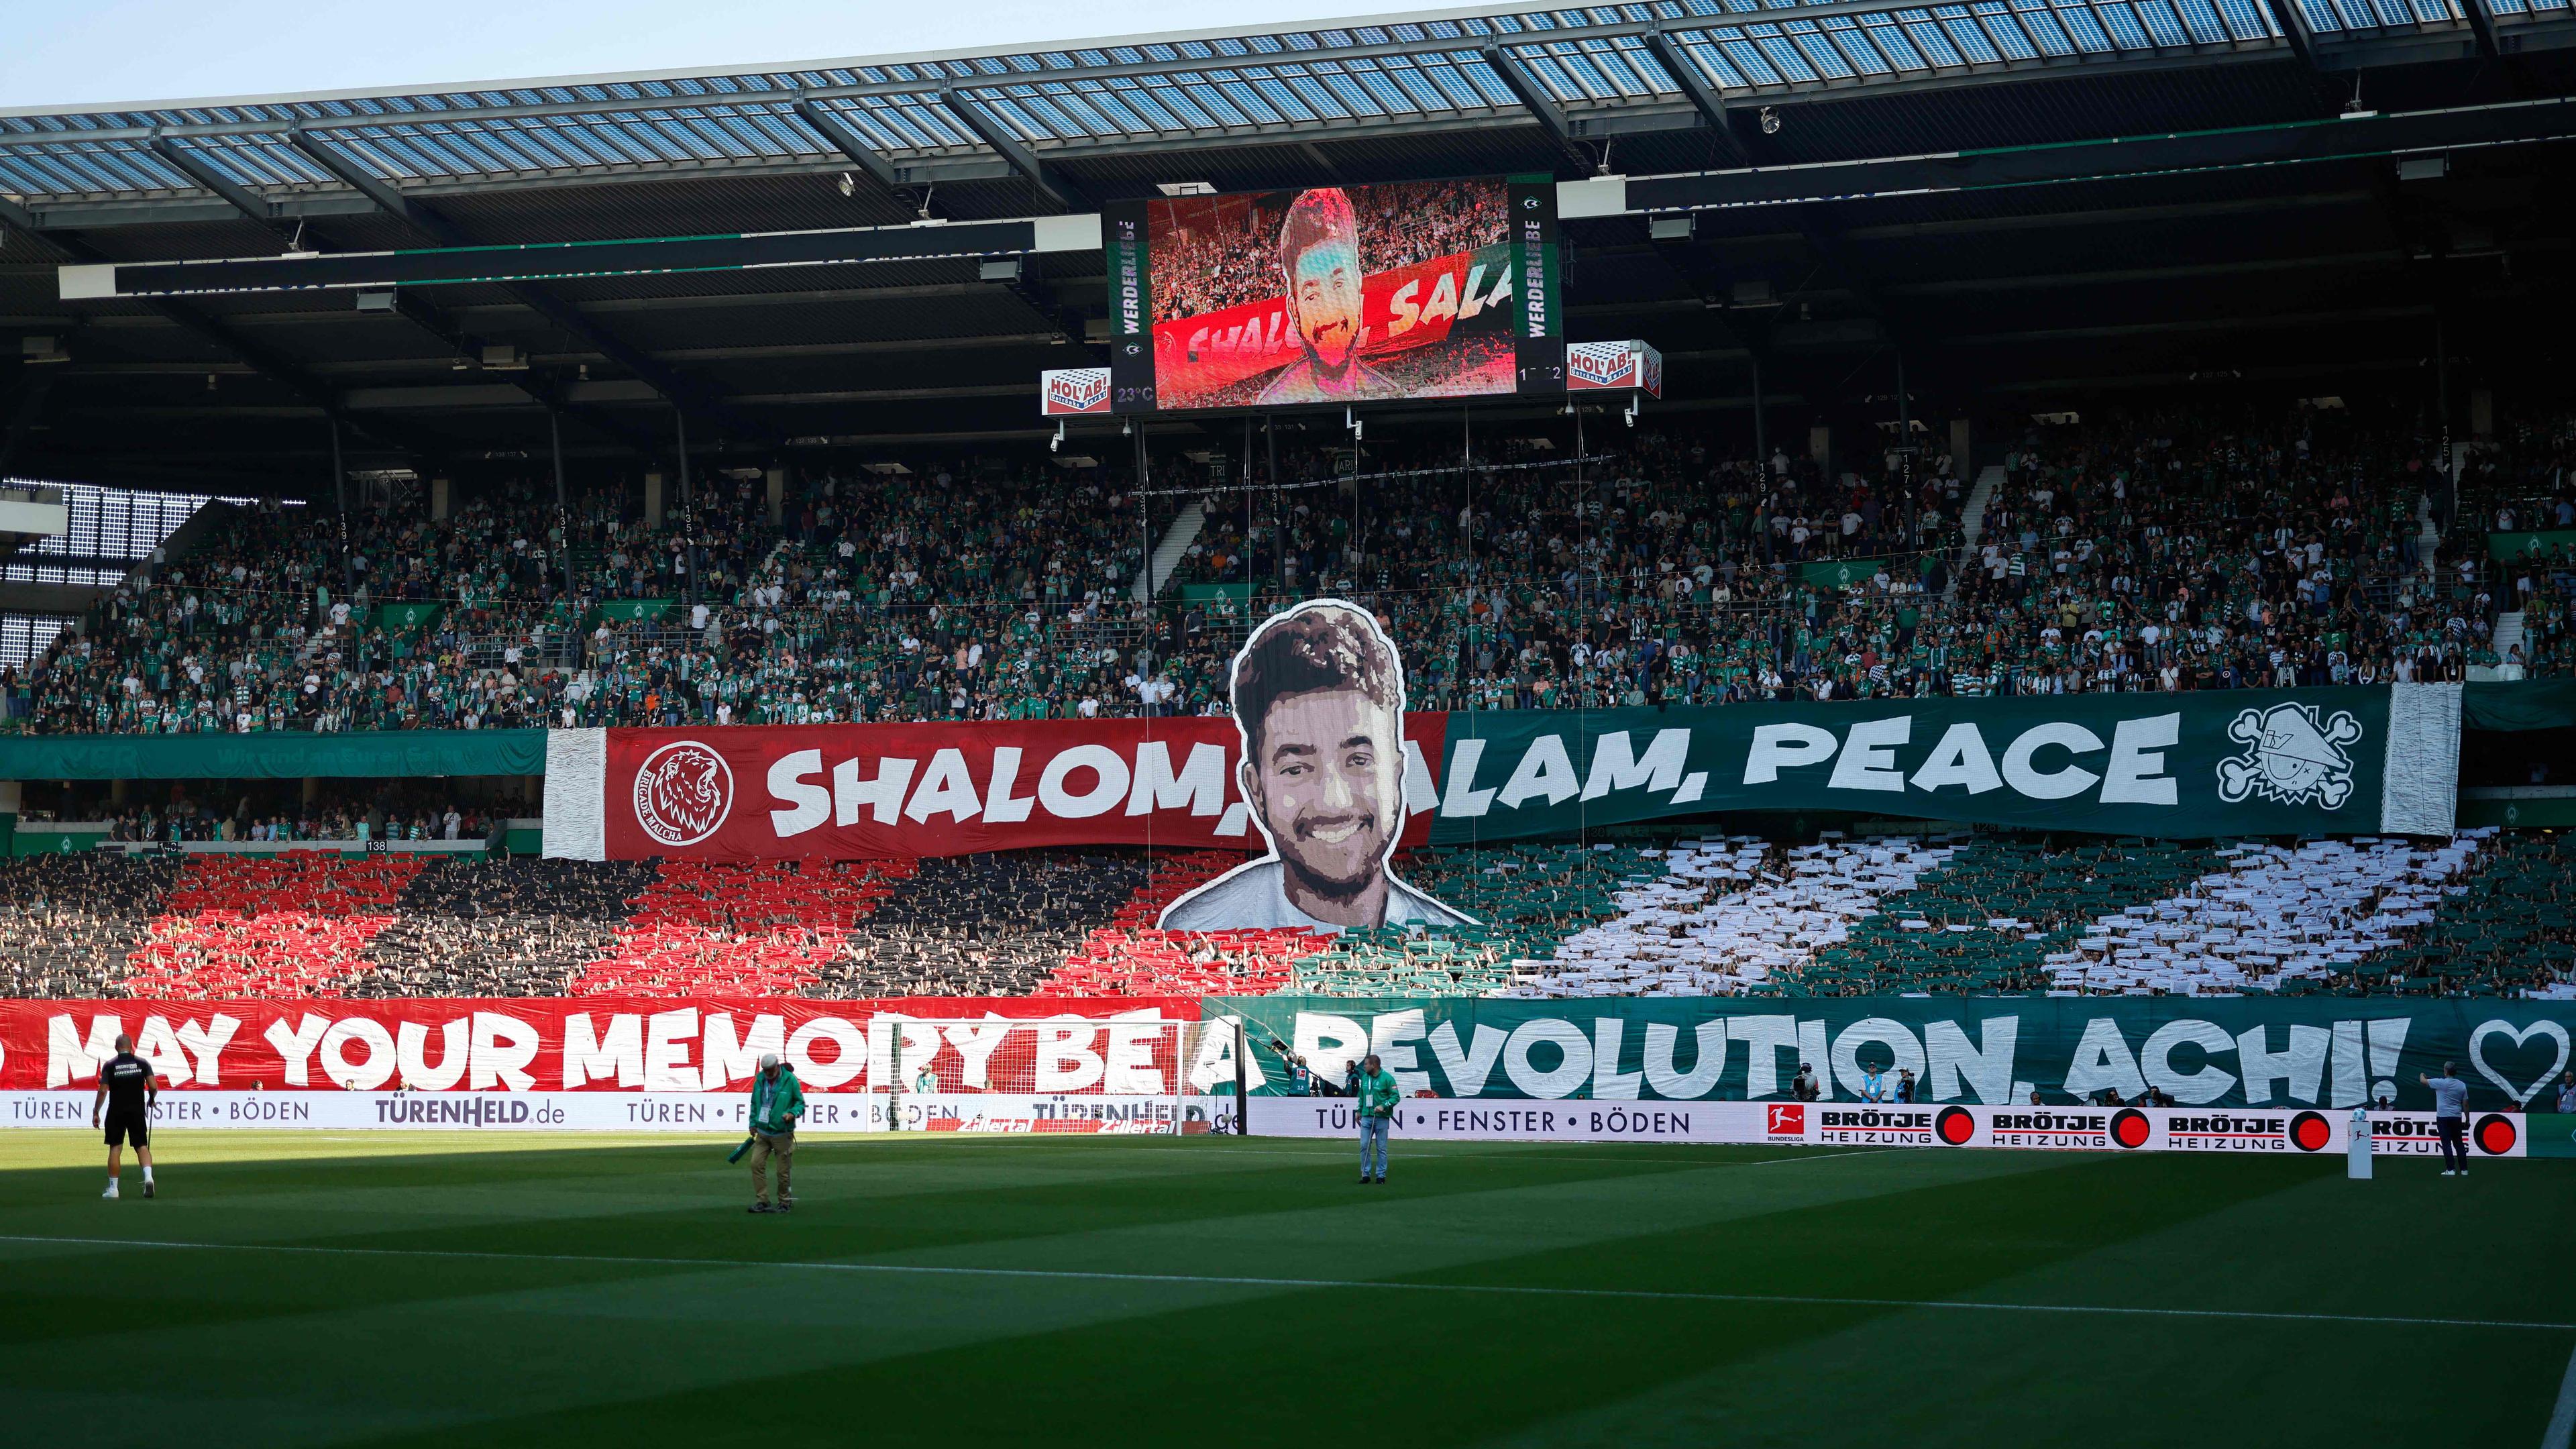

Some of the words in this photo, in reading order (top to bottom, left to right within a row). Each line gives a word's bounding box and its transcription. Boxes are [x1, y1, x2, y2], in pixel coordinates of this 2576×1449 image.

[1525, 220, 1545, 338] WERDERLIEBE
[1571, 368, 1603, 382] Getränke
[1607, 367, 1631, 382] Markt
[1051, 394, 1080, 407] Getränke
[1083, 391, 1106, 407] Markt
[767, 741, 1250, 839] SHALOM,
[1743, 712, 2181, 806] PEACE
[639, 769, 651, 817] BRIGADE
[646, 816, 682, 841] MALCHA
[368, 841, 386, 851] 138
[46, 1012, 241, 1090] MAY
[264, 1012, 539, 1091] YOUR
[563, 1006, 1013, 1091] MEMORY
[1034, 1007, 1166, 1095] BE
[1187, 1015, 1267, 1095] A
[2063, 1015, 2410, 1109] ACHI!
[13, 1097, 82, 1120] TÜREN
[229, 1097, 309, 1120] BÖDEN
[627, 1098, 705, 1123] TÜREN
[1821, 1108, 1931, 1128] BRÖTJE
[957, 1118, 1034, 1133] Zillertal
[1098, 1119, 1175, 1134] Zillertal
[1438, 1110, 1555, 1133] FENSTER
[1591, 1107, 1690, 1134] BÖDEN
[1993, 1111, 2106, 1130] BRÖTJE
[2169, 1114, 2285, 1133] BRÖTJE
[1821, 1132, 1931, 1143] HEIZUNG
[1993, 1134, 2106, 1146] HEIZUNG
[2169, 1137, 2285, 1150] HEIZUNG
